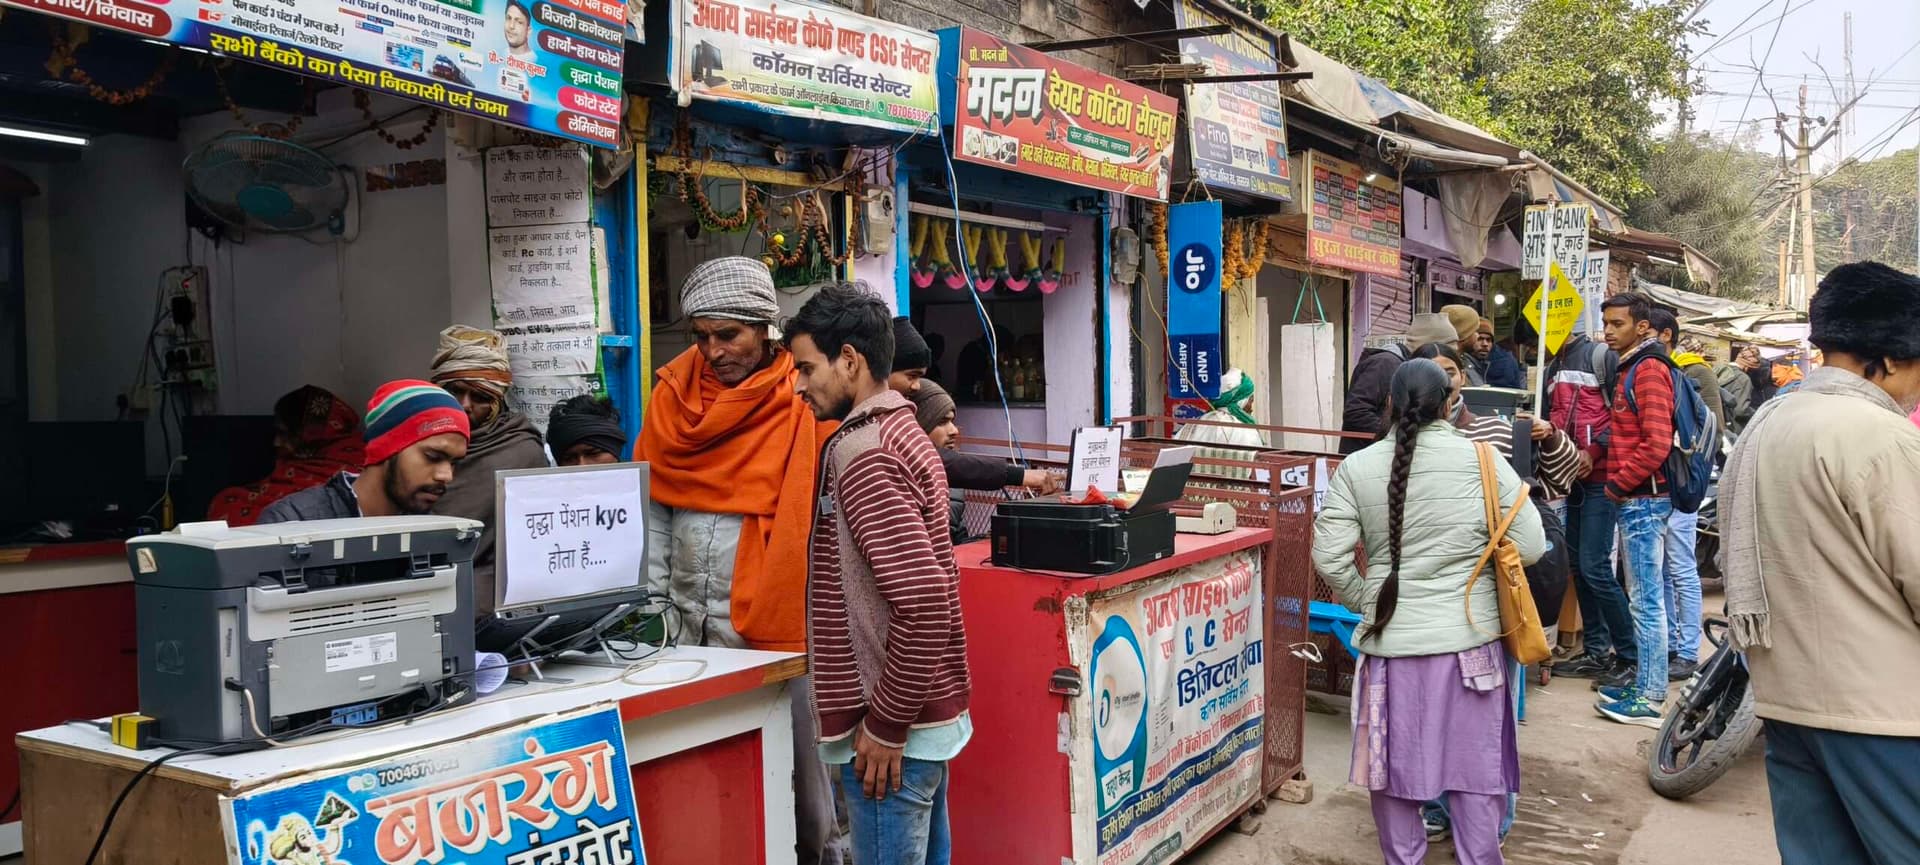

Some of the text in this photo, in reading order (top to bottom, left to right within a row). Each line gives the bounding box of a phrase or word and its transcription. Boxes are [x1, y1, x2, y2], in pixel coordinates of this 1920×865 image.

[249, 5, 269, 17] कार्ड
[303, 18, 322, 31] प्राप्त
[381, 4, 416, 22] Online
[417, 14, 441, 30] किया
[441, 22, 463, 35] जाता
[441, 6, 451, 17] या
[452, 10, 485, 28] अनुदान
[541, 4, 577, 30] बिजली
[602, 2, 624, 20] कार्ड
[693, 0, 740, 35] अजय
[744, 3, 798, 46] साईबर
[802, 10, 834, 51] कैफे
[870, 32, 897, 68] CSC
[901, 38, 932, 75] सेन्टर
[597, 49, 621, 68] फोटो
[981, 48, 997, 63] मदन
[998, 46, 1008, 63] जी
[210, 32, 257, 57] सभी
[307, 56, 337, 76] का
[339, 60, 378, 86] पैसा
[379, 69, 445, 103] निकासी
[447, 90, 473, 110] एवं
[473, 97, 509, 118] जमा
[730, 78, 748, 92] सभी
[749, 81, 769, 95] प्रकार
[779, 84, 796, 98] फार्म
[752, 51, 913, 99] कॉमन सर्विस सेन्टर
[574, 91, 618, 117] फोटो स्टेट
[966, 66, 1047, 126] मदन
[1087, 84, 1134, 132] कटिंग
[1136, 95, 1174, 152] सैलून
[568, 113, 617, 140] लेमिनेशन
[1207, 123, 1228, 144] Fino
[550, 192, 561, 201] का
[564, 188, 583, 201] फोटो
[1525, 206, 1587, 233] FIN BANK
[530, 232, 552, 242] आधार
[1525, 229, 1585, 260] आधर कार्ड
[520, 277, 549, 288] निकलता
[1185, 249, 1206, 290] Jio
[506, 343, 520, 354] नता
[584, 336, 593, 349] भी
[1178, 342, 1189, 394] AIRFIBER
[1196, 350, 1209, 384] MNP
[525, 503, 628, 540] वृद्धा पेंशन kyc
[548, 543, 577, 574] होता
[1143, 586, 1180, 637] अजय
[1176, 655, 1239, 708] डिजिटल
[366, 738, 616, 865] बजरंग
